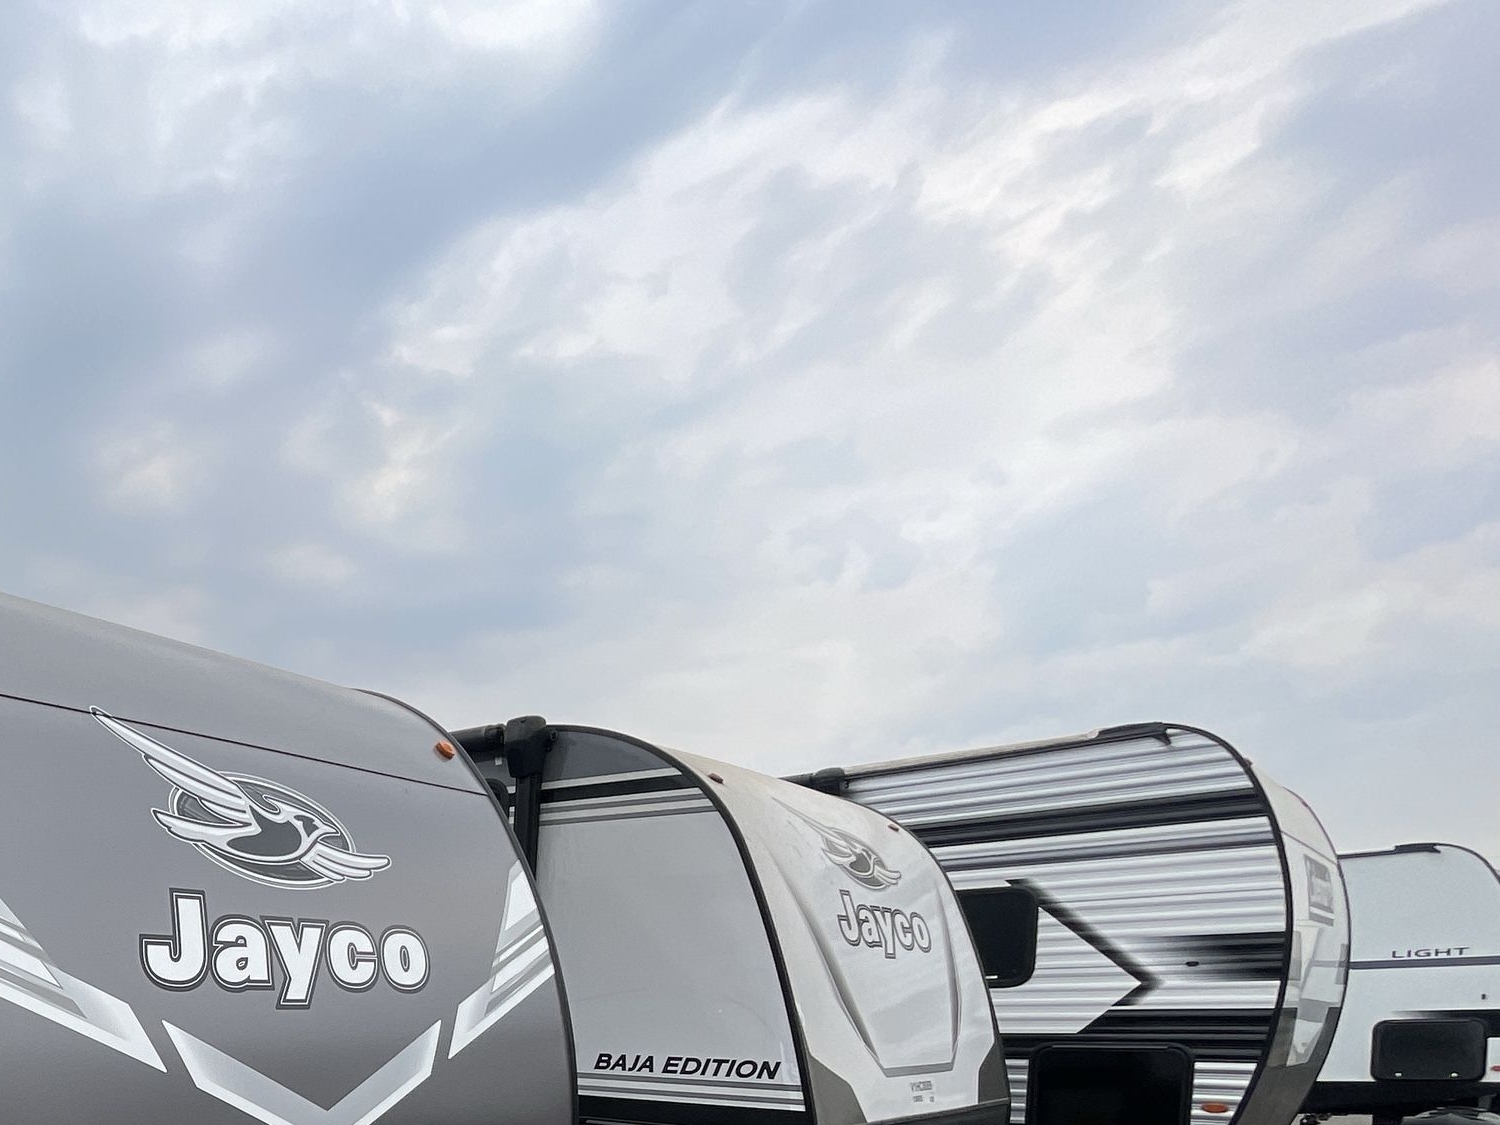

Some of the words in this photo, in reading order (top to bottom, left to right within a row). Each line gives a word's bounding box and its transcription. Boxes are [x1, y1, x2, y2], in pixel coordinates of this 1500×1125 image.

[837, 889, 931, 959] Jayco
[139, 887, 430, 1010] Jayco
[1392, 947, 1470, 959] LIGHT
[594, 1053, 654, 1073] BAJA
[662, 1056, 781, 1080] EDITION
